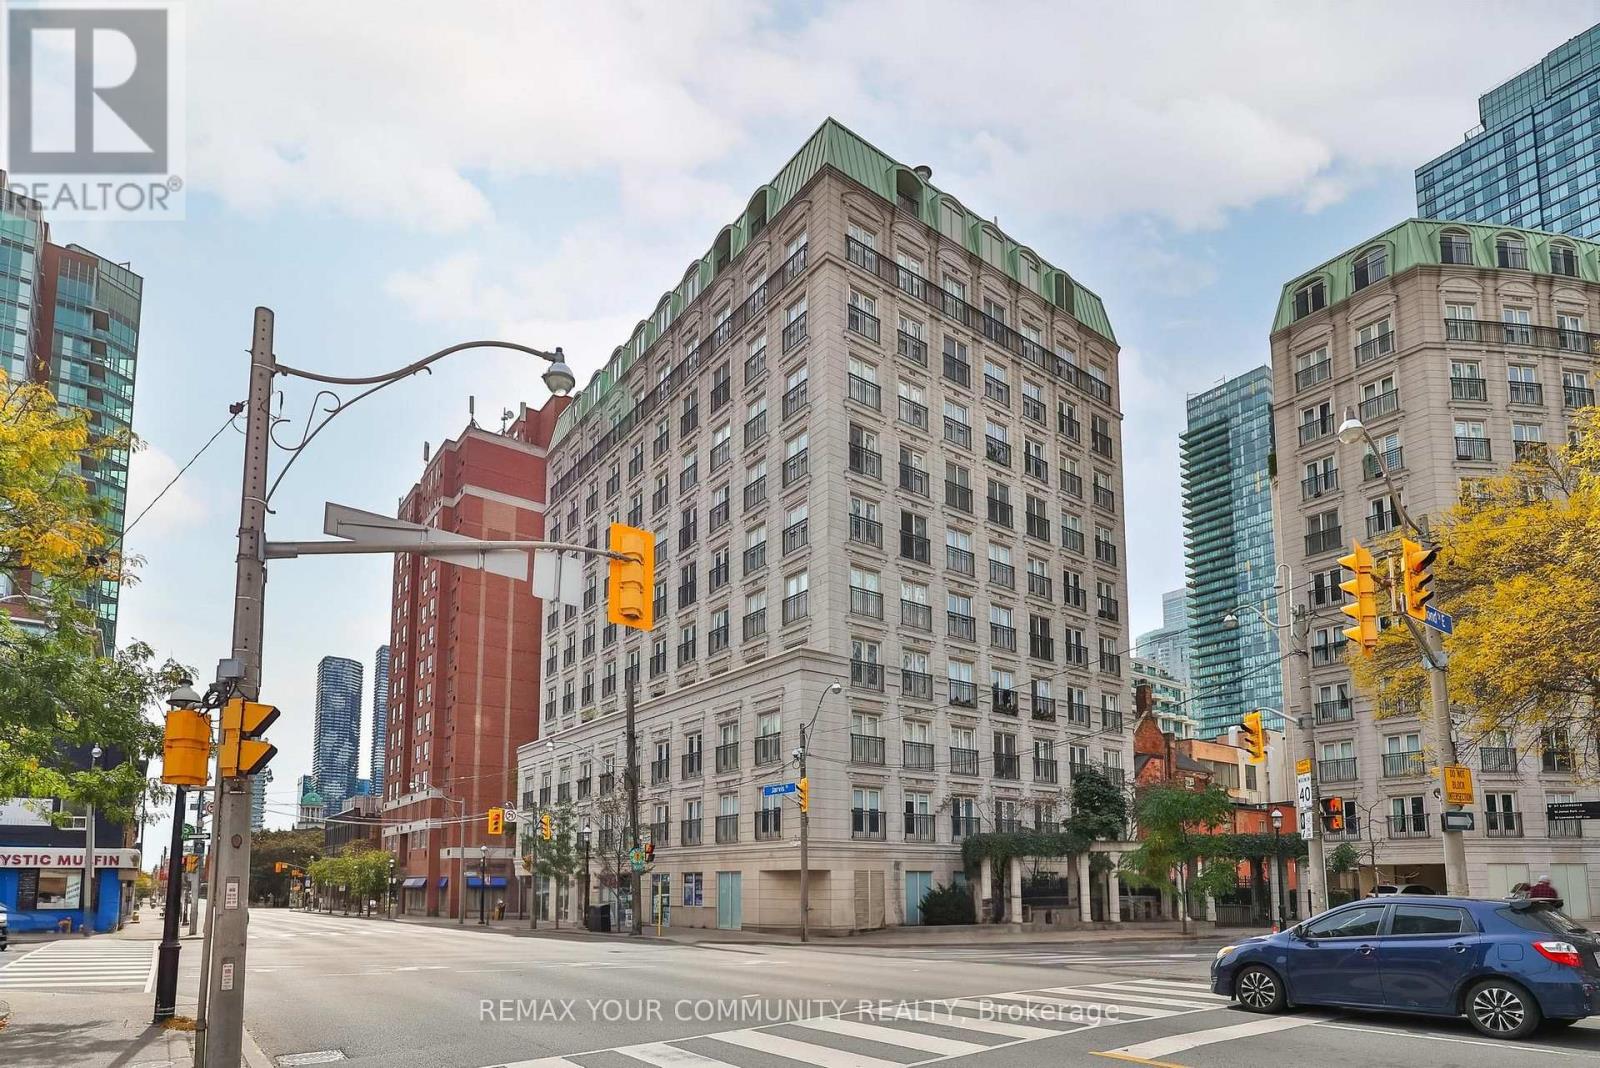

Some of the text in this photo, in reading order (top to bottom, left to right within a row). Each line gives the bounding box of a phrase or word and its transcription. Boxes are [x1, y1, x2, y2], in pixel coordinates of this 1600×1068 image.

[1300, 786, 1311, 802] 40
[0, 854, 120, 866] YSTIC MUFIN
